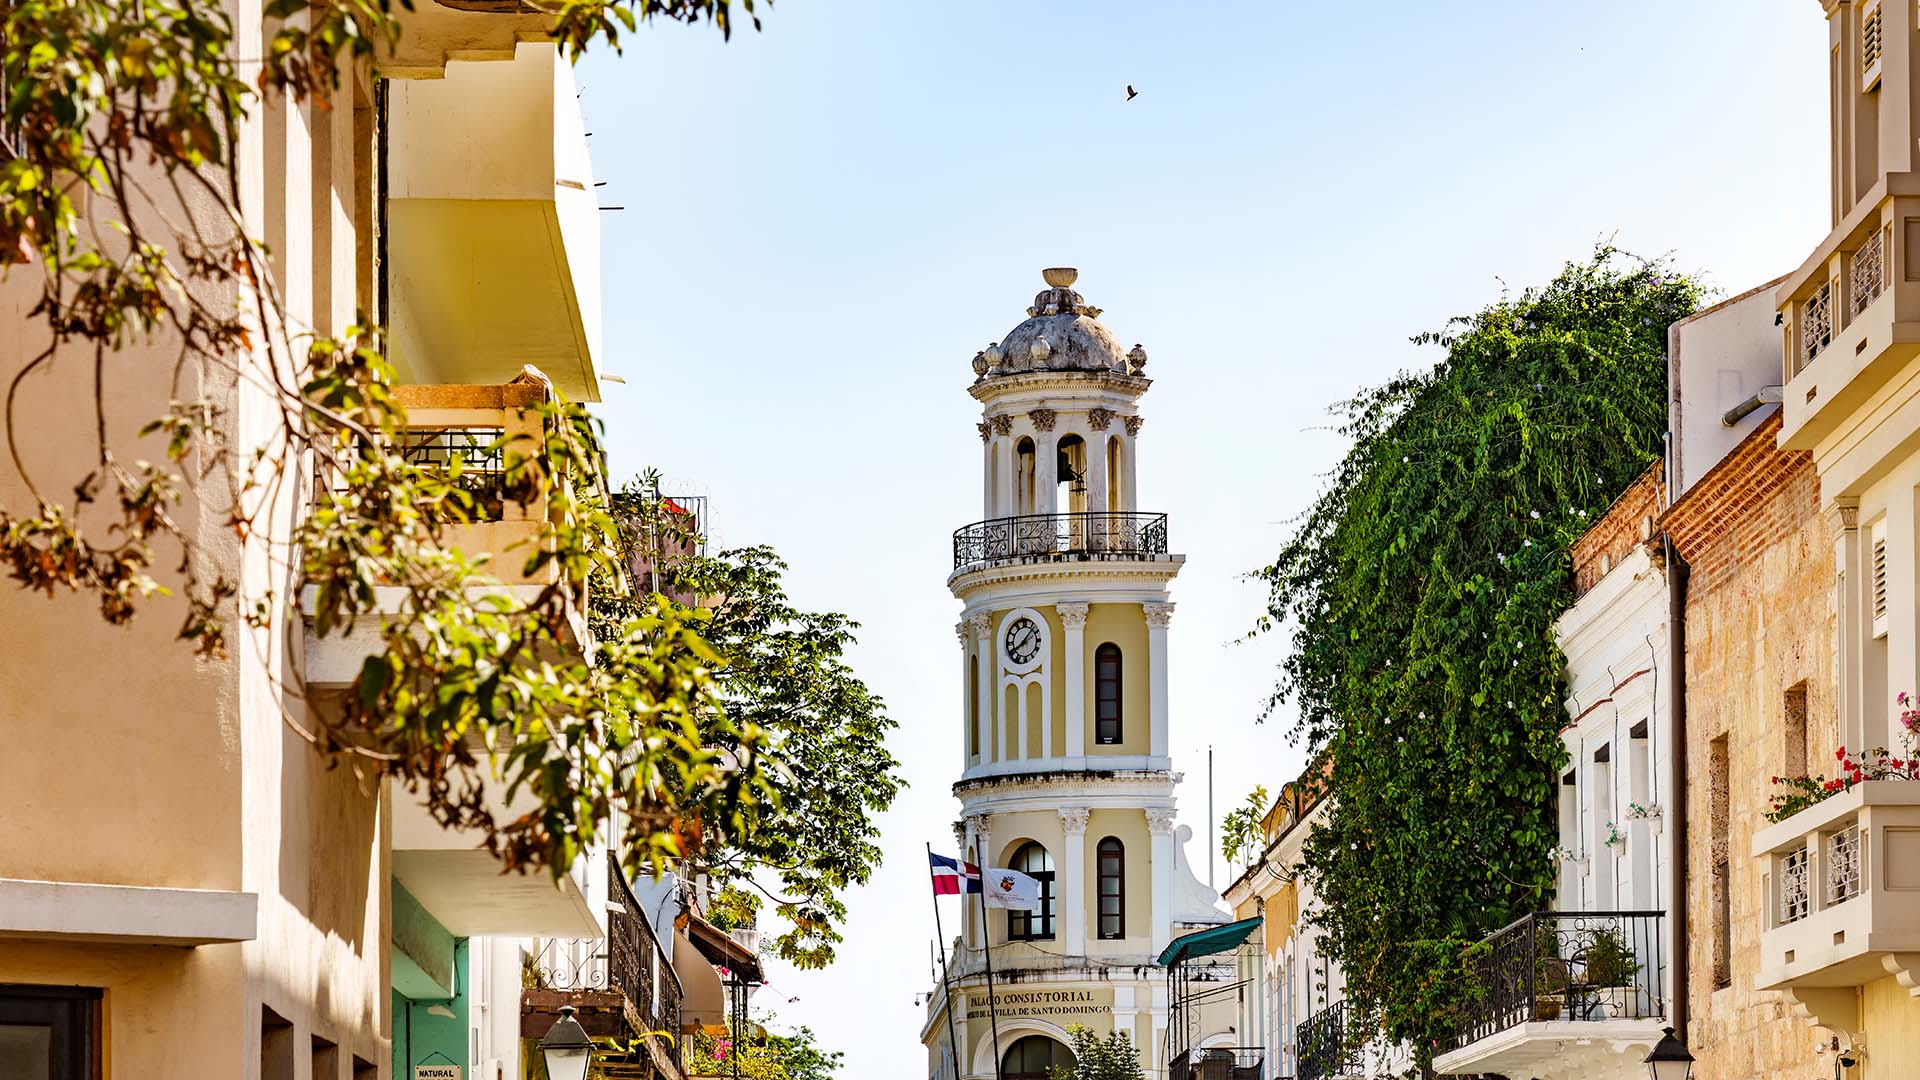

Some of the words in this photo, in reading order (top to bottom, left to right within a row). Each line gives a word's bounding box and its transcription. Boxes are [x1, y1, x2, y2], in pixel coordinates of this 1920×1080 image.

[971, 995, 1001, 1007] PALACO
[1003, 991, 1094, 1005] CONSISTORIAL
[995, 1008, 1017, 1017] VILLA
[1019, 1007, 1029, 1016] DE
[419, 1070, 455, 1078] NATURAL
